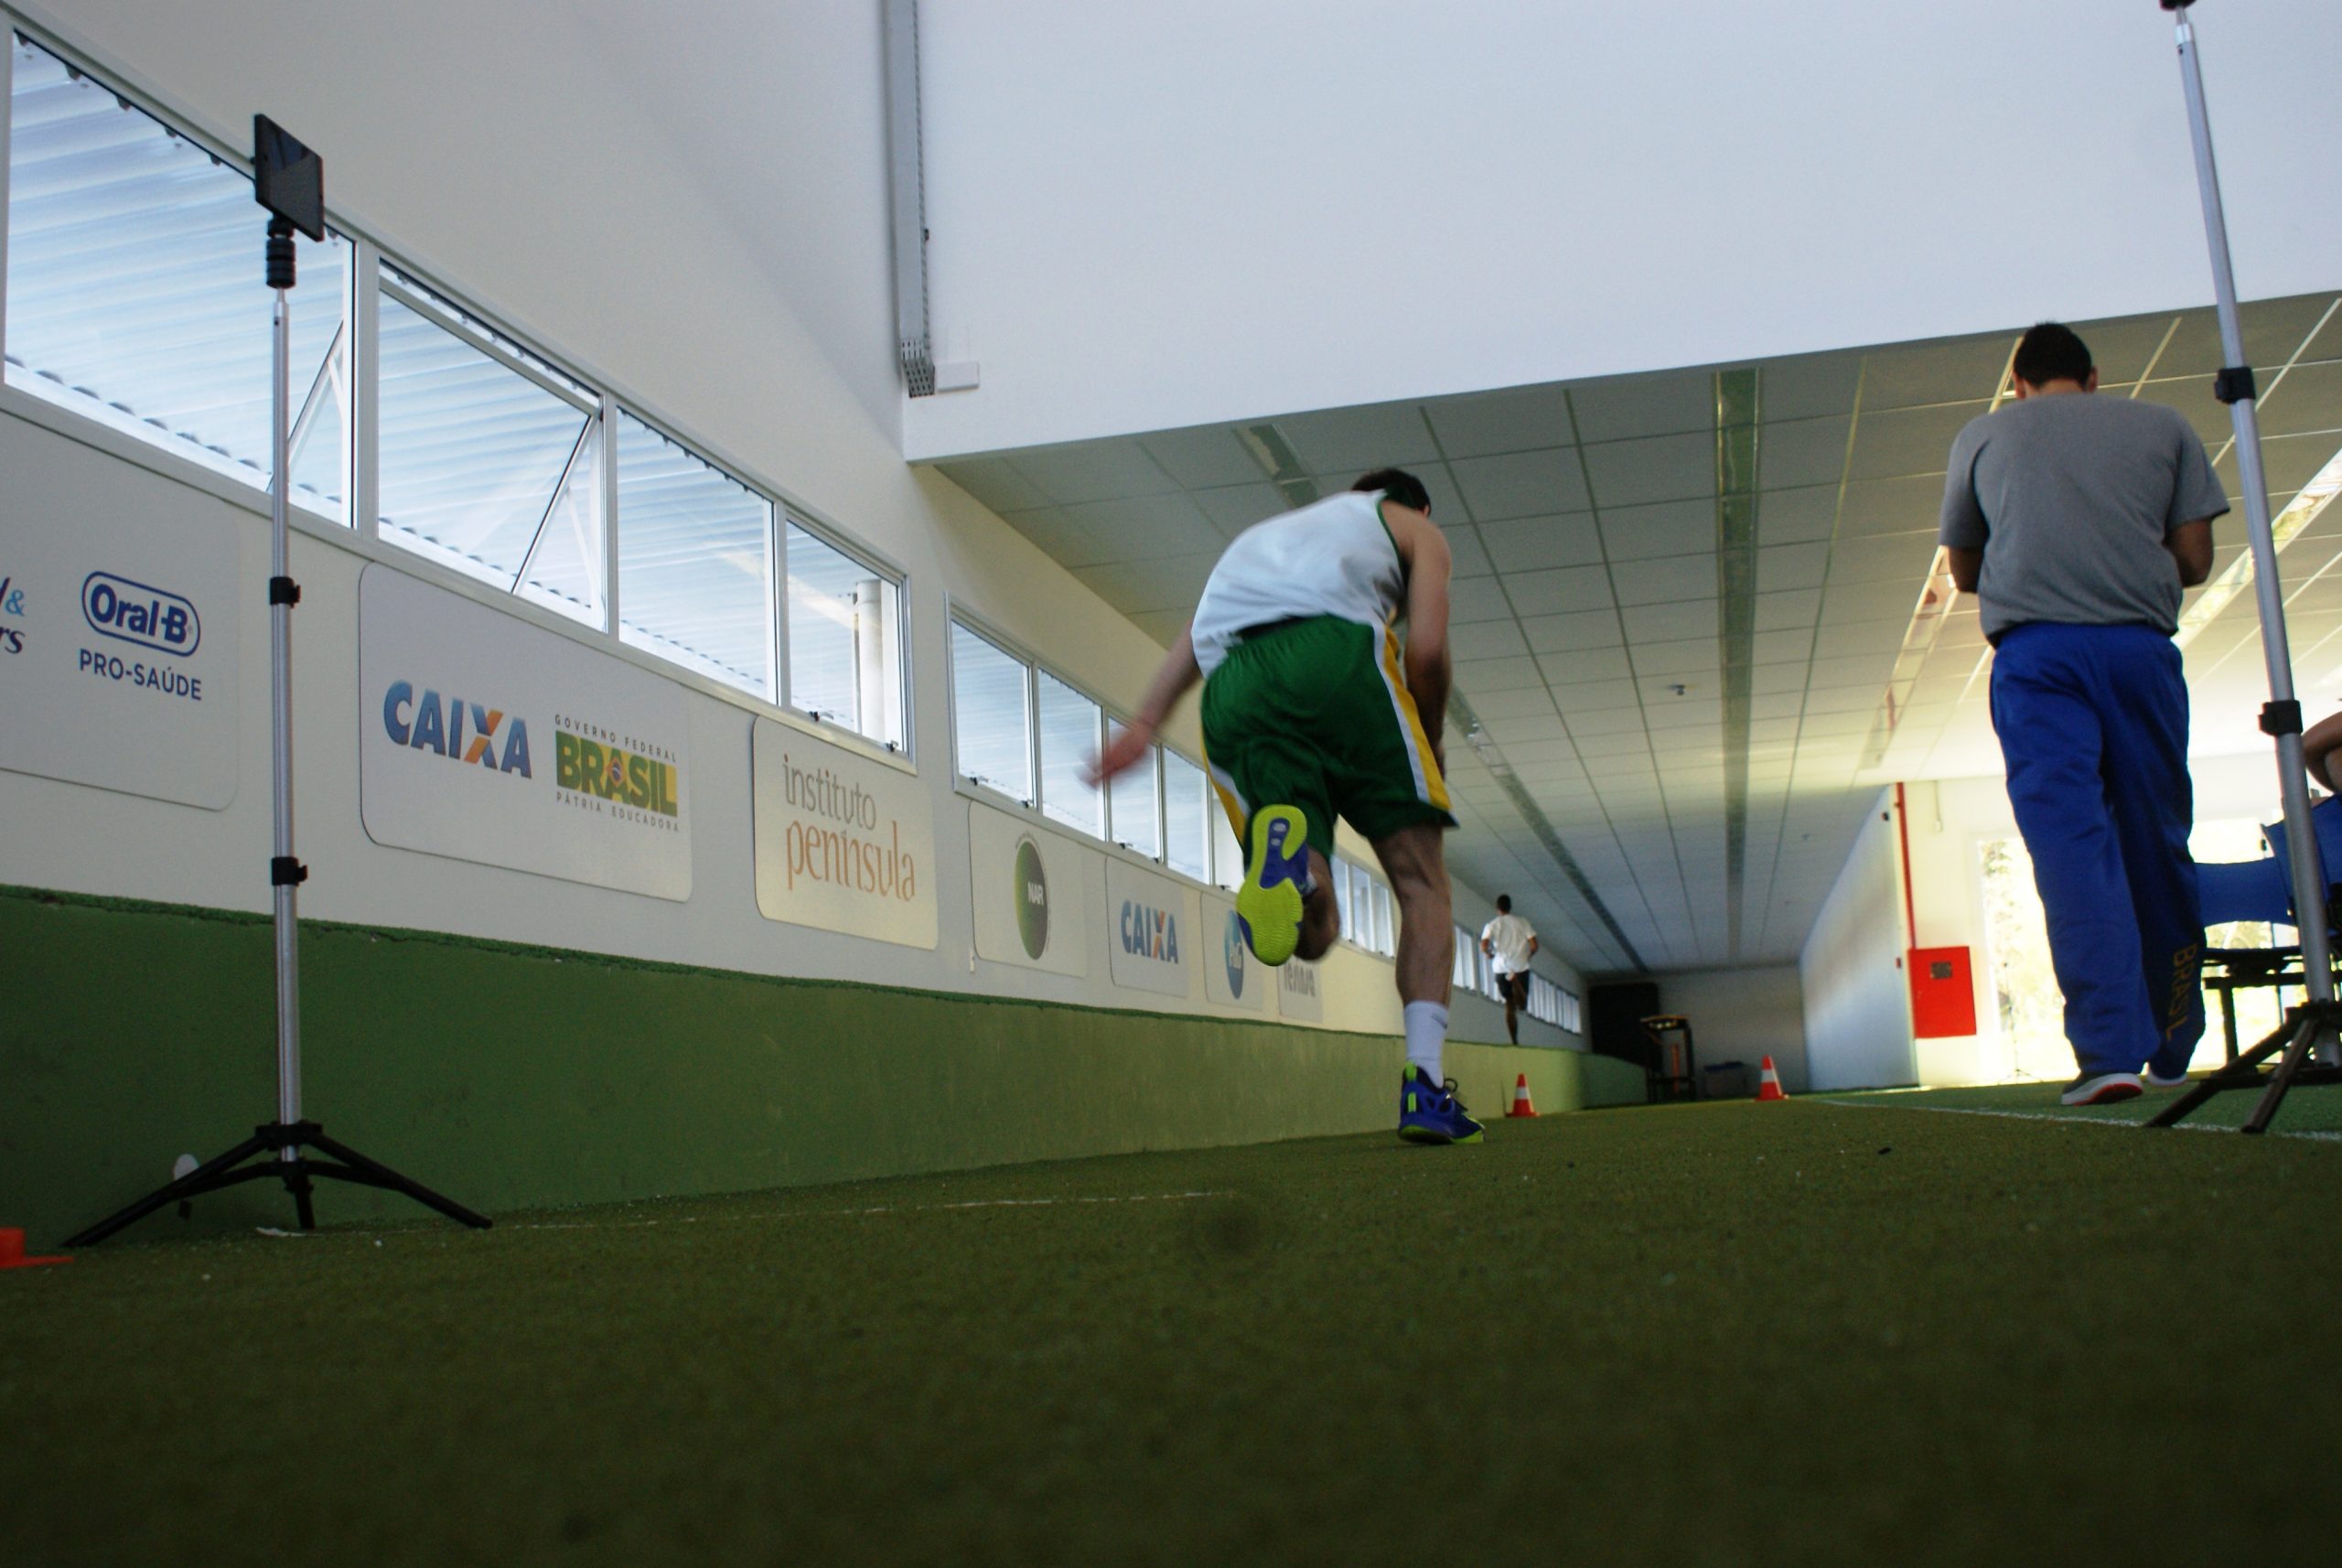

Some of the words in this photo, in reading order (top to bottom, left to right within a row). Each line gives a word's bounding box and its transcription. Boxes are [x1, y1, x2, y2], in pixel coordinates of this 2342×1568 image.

[90, 583, 189, 645] Oral-B
[79, 648, 203, 701] PRO-SAÚDE
[383, 679, 532, 780] CAIXA
[554, 714, 616, 743] GOVERNO
[624, 736, 677, 763] FEDERAL
[554, 729, 678, 818] BRASIL
[782, 753, 876, 831] instituto
[556, 789, 602, 812] PÁTRIA
[611, 806, 680, 833] EDUCADORA
[1027, 882, 1045, 907] NAR
[1120, 898, 1180, 965] CAIXA
